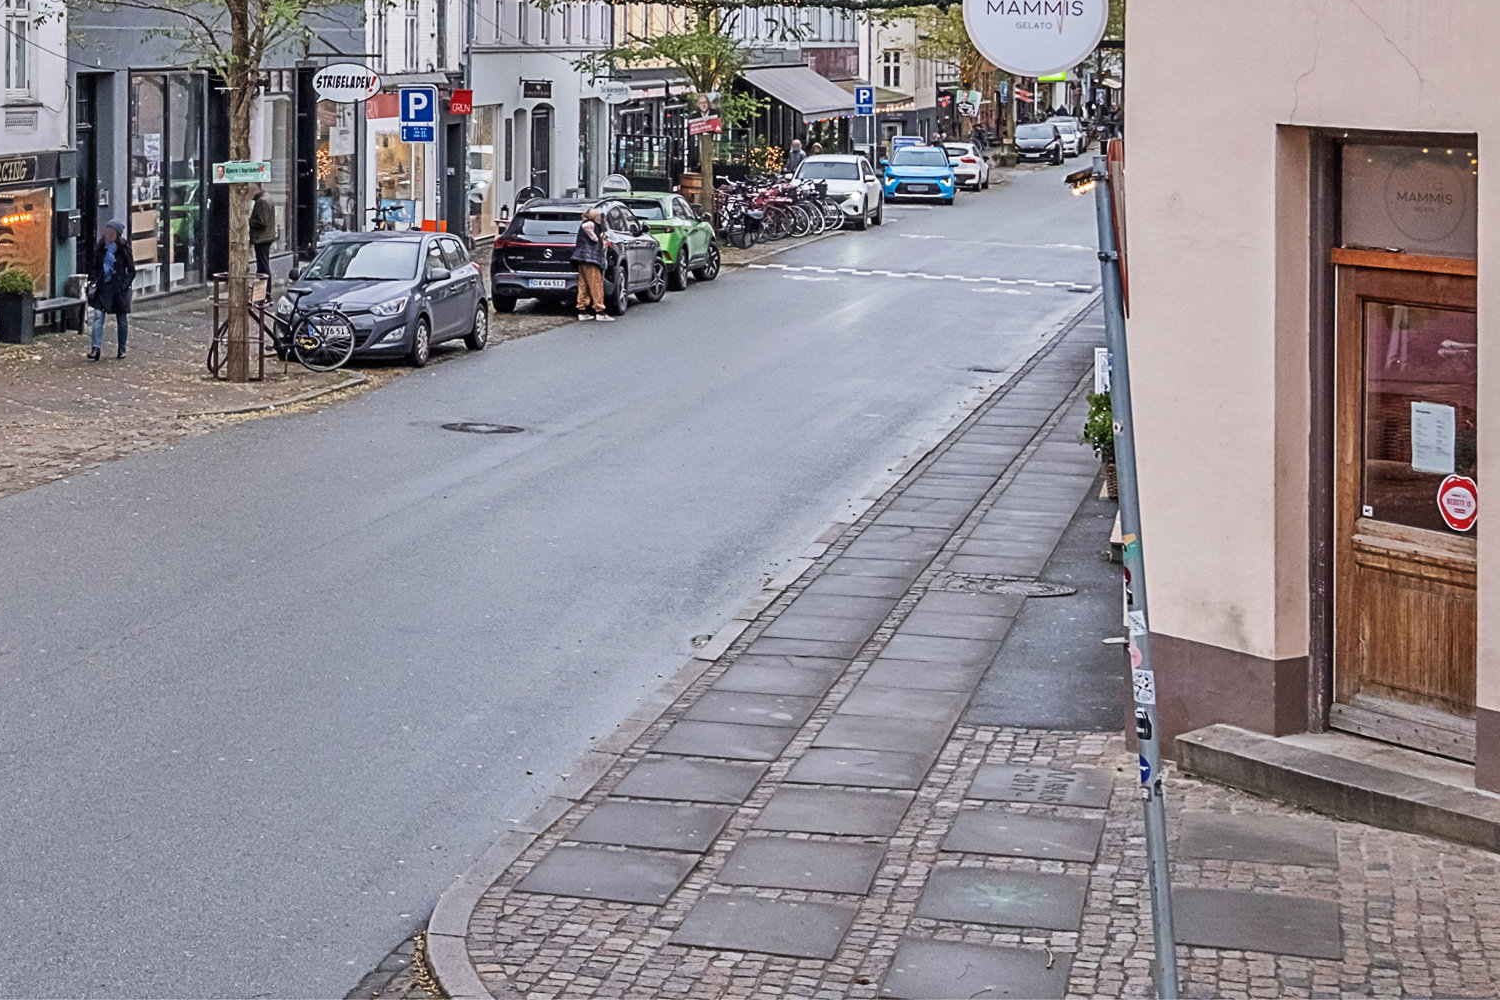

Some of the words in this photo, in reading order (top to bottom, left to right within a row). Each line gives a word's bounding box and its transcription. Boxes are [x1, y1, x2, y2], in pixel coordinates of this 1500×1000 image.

[987, 0, 1083, 16] MAMMIS
[1015, 22, 1053, 30] GELATO
[316, 75, 377, 92] STRIBELADEN!
[859, 89, 870, 104] P
[409, 92, 428, 119] P
[1396, 190, 1453, 205] MAMMIS
